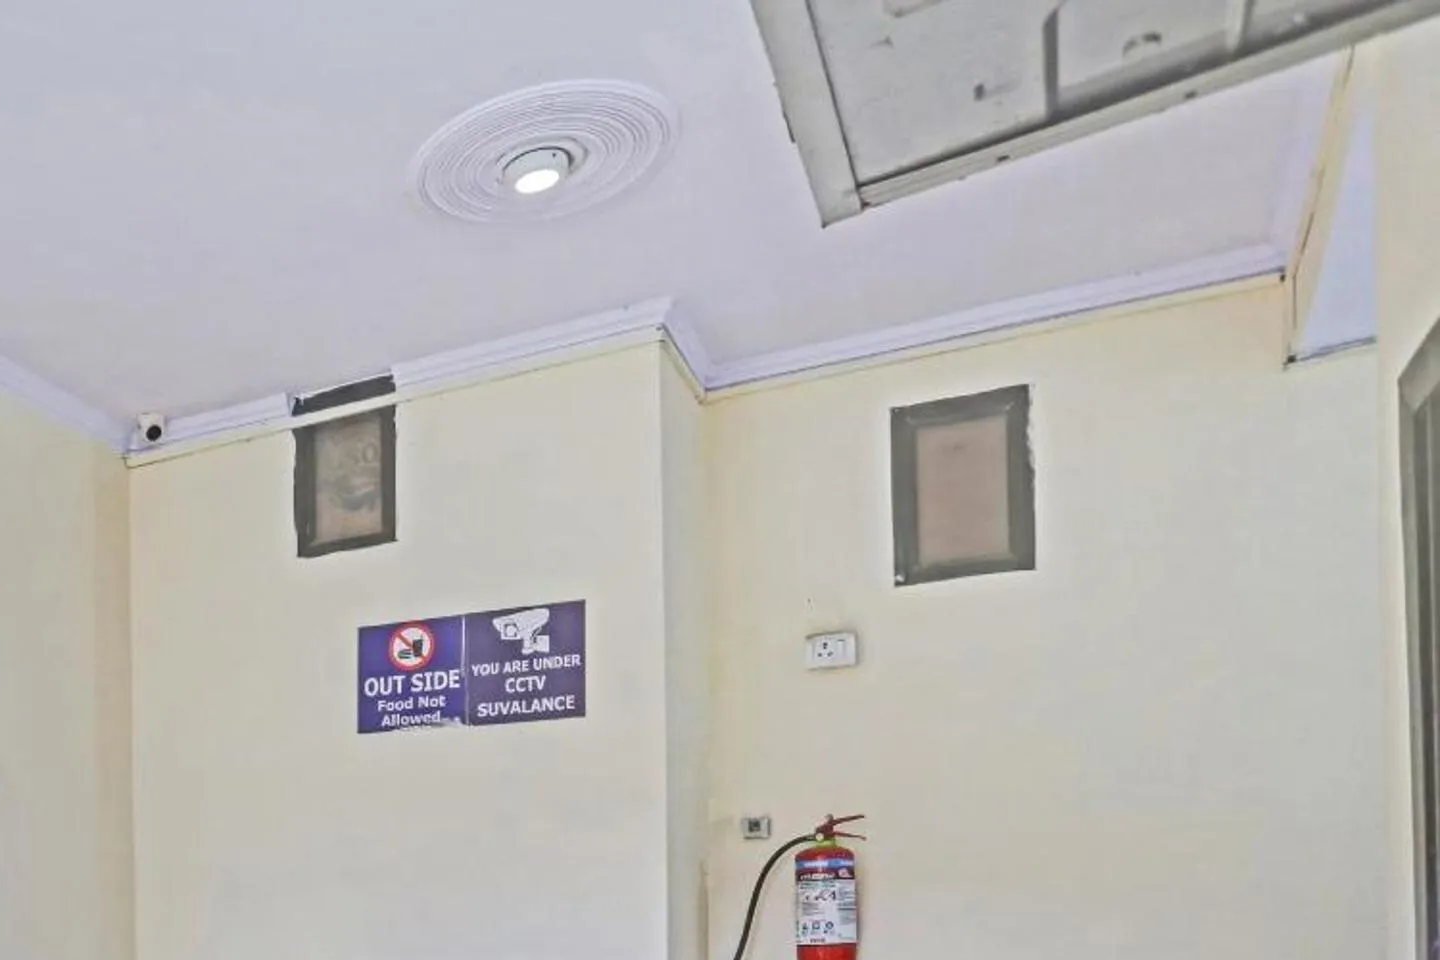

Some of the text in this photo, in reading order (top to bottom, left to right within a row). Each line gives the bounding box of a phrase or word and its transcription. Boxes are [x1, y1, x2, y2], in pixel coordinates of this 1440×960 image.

[471, 654, 582, 676] YOU ARE UNDER
[364, 669, 460, 697] OUT SIDE
[505, 675, 546, 693] CCTV
[377, 694, 447, 712] Food Not
[477, 695, 576, 717] SUVALANCE
[381, 710, 441, 727] Allowed
